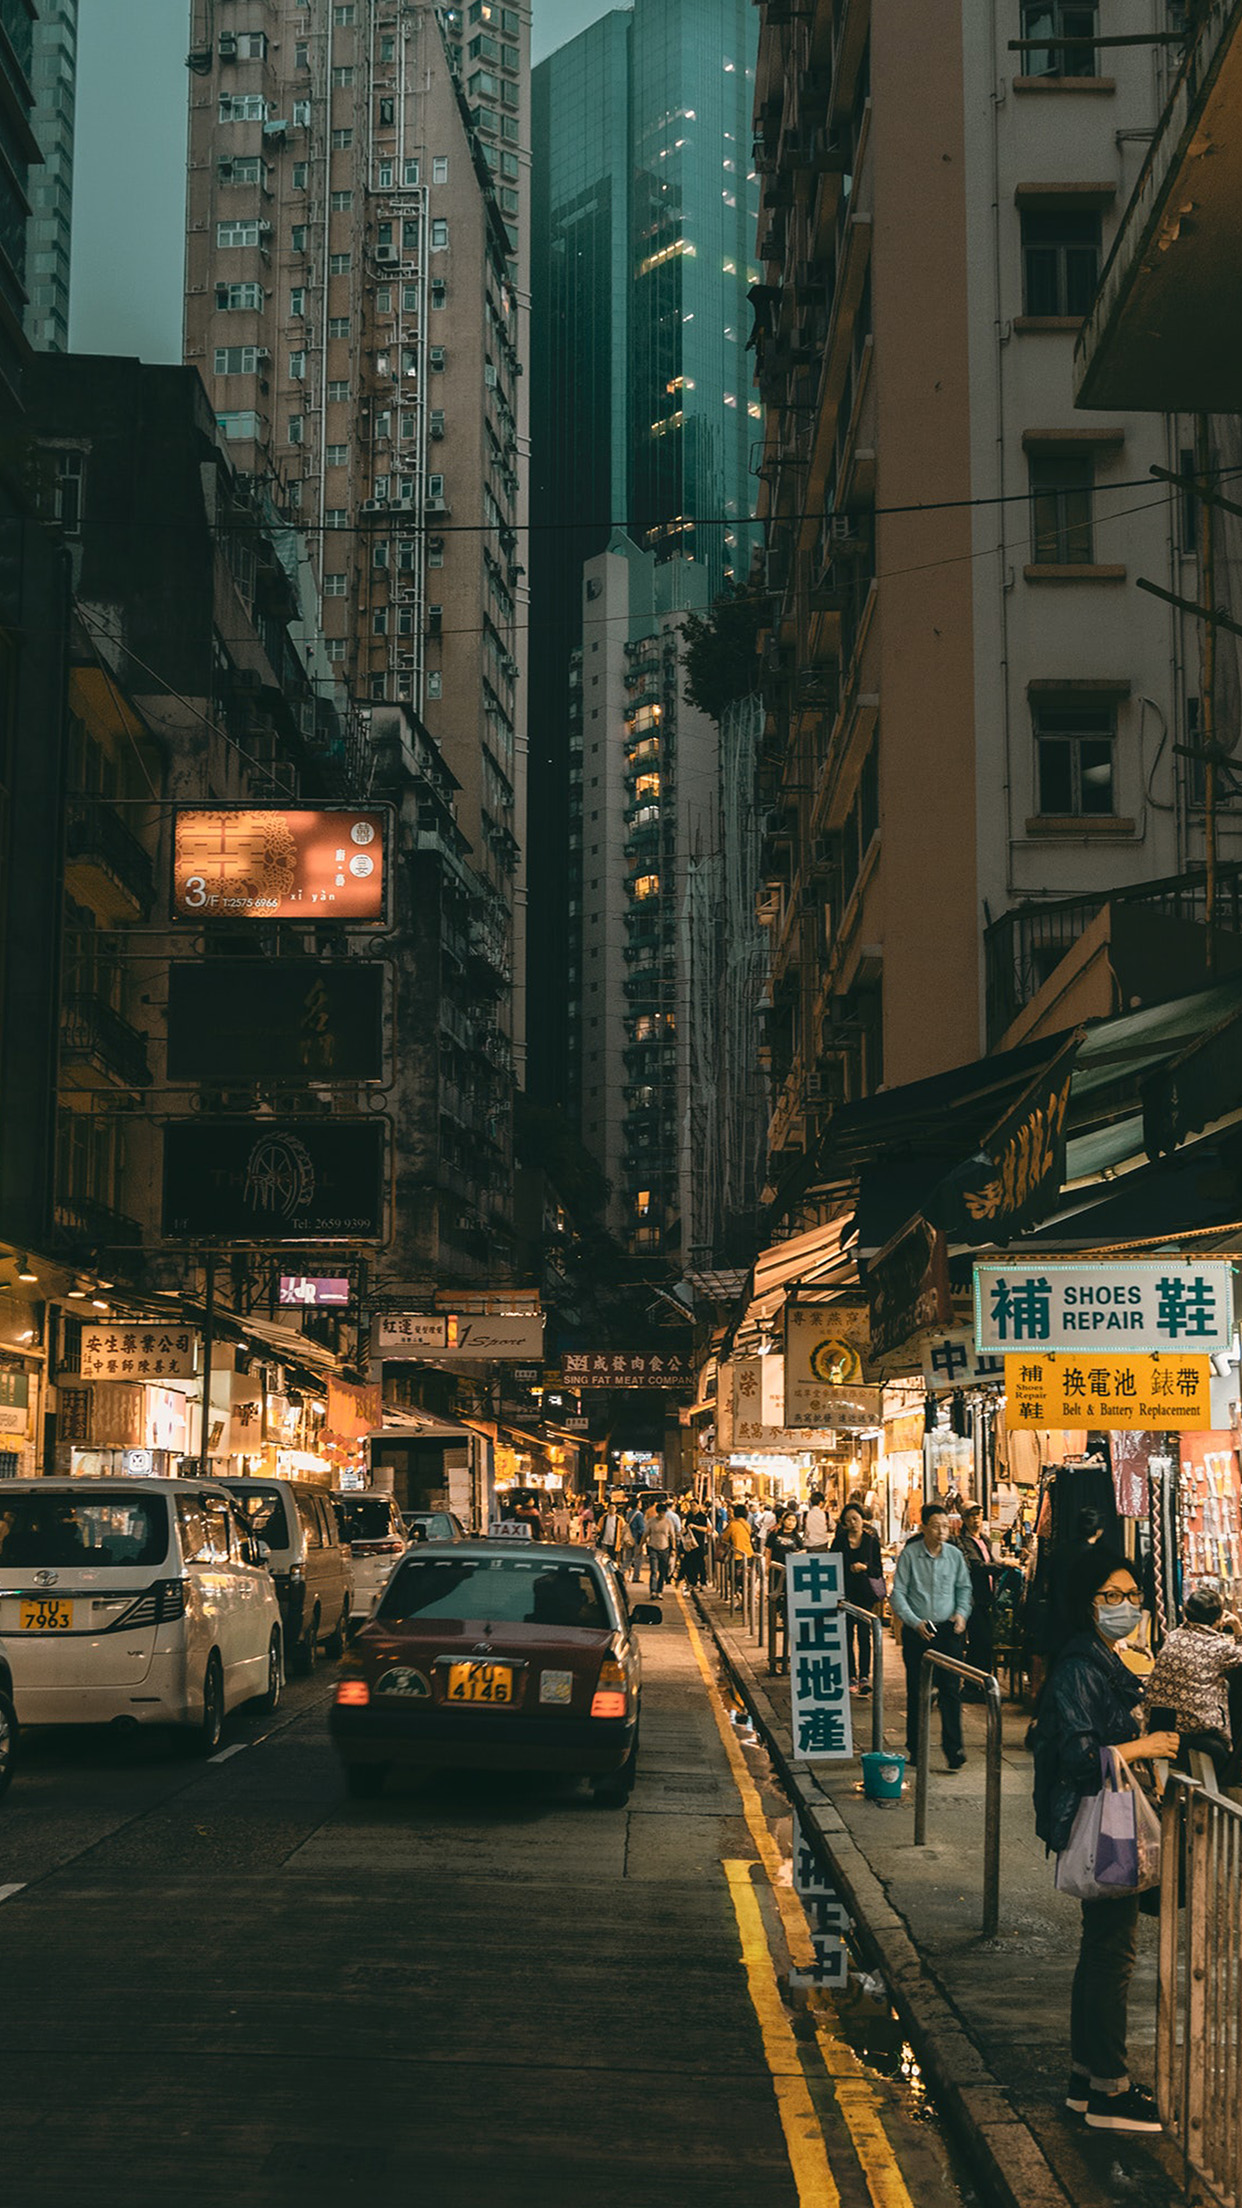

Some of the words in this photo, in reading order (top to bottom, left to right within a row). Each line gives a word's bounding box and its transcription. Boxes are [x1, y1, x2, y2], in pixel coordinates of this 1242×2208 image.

[185, 876, 219, 907] 3/F
[255, 898, 278, 908] 6966
[315, 1219, 341, 1229] 2659
[344, 1219, 371, 1229] 9399
[1063, 1286, 1141, 1305] SHOES
[990, 1276, 1052, 1340] 補
[1155, 1276, 1218, 1339] 鞋
[1063, 1310, 1144, 1330] REPAIR
[86, 1333, 190, 1354] 安生藥業公司
[563, 1376, 588, 1385] SING
[592, 1376, 611, 1385] FAT
[615, 1376, 645, 1385] MEAT
[1018, 1364, 1043, 1382] 補
[1015, 1391, 1047, 1400] Repair
[1016, 1384, 1044, 1392] Shoes
[1018, 1402, 1045, 1420] 鞋
[1062, 1403, 1081, 1416] Belt
[1087, 1403, 1094, 1416] &
[1100, 1403, 1134, 1419] Battery
[1139, 1402, 1200, 1419] Replacement
[492, 1524, 527, 1536] TAXI
[37, 1601, 60, 1615] TU
[25, 1614, 69, 1629] 7963
[792, 1558, 847, 1753] 中正地產
[453, 1684, 507, 1700] 4146
